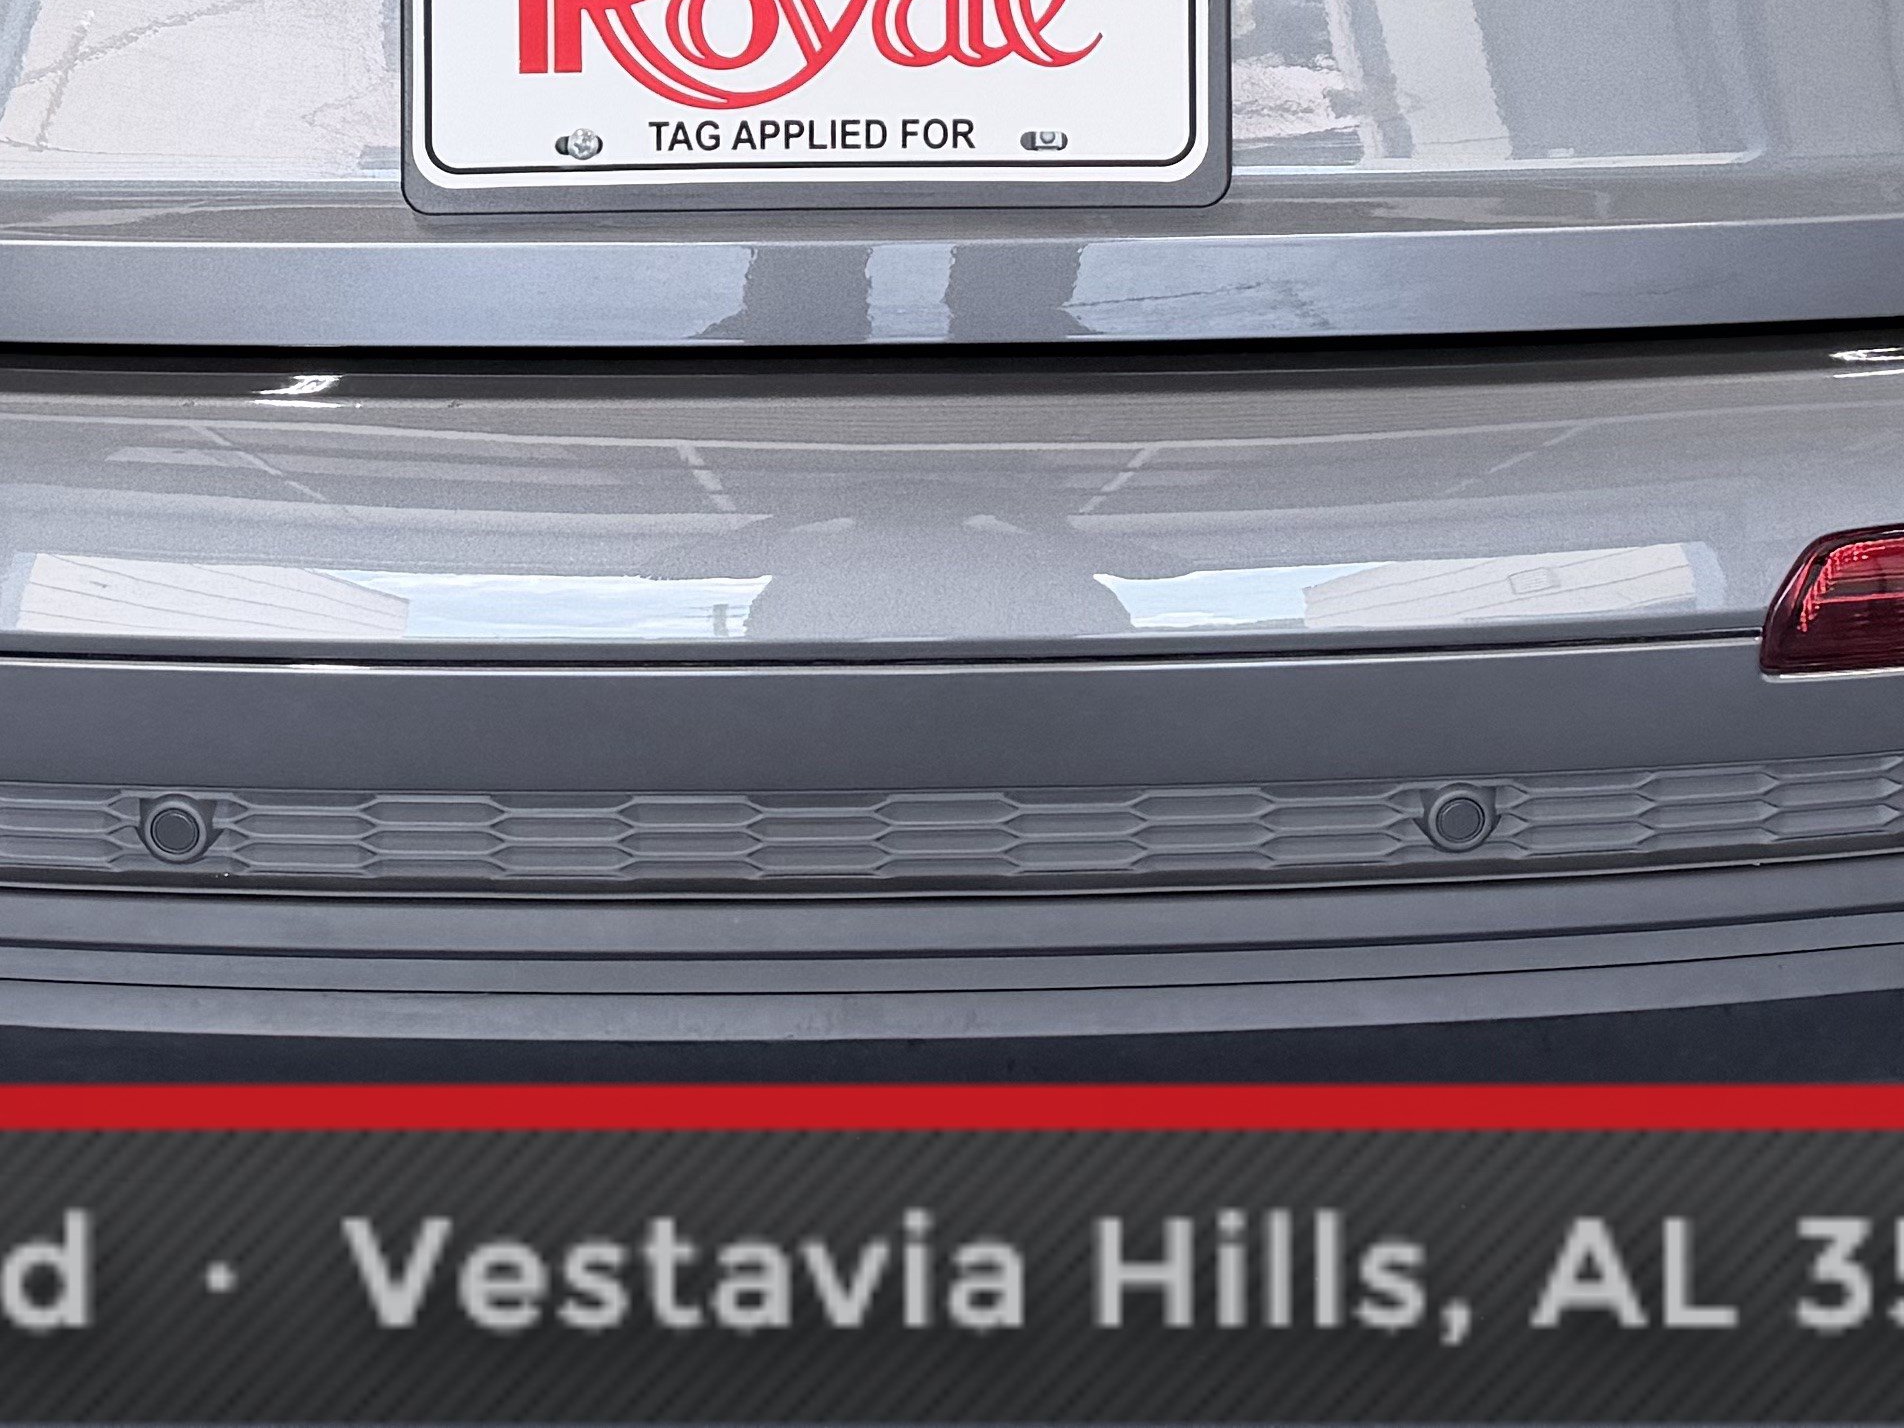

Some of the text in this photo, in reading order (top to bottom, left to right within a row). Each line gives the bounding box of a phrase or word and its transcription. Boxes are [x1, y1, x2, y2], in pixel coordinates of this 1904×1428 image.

[648, 118, 976, 151] TAG APPLIED FOR
